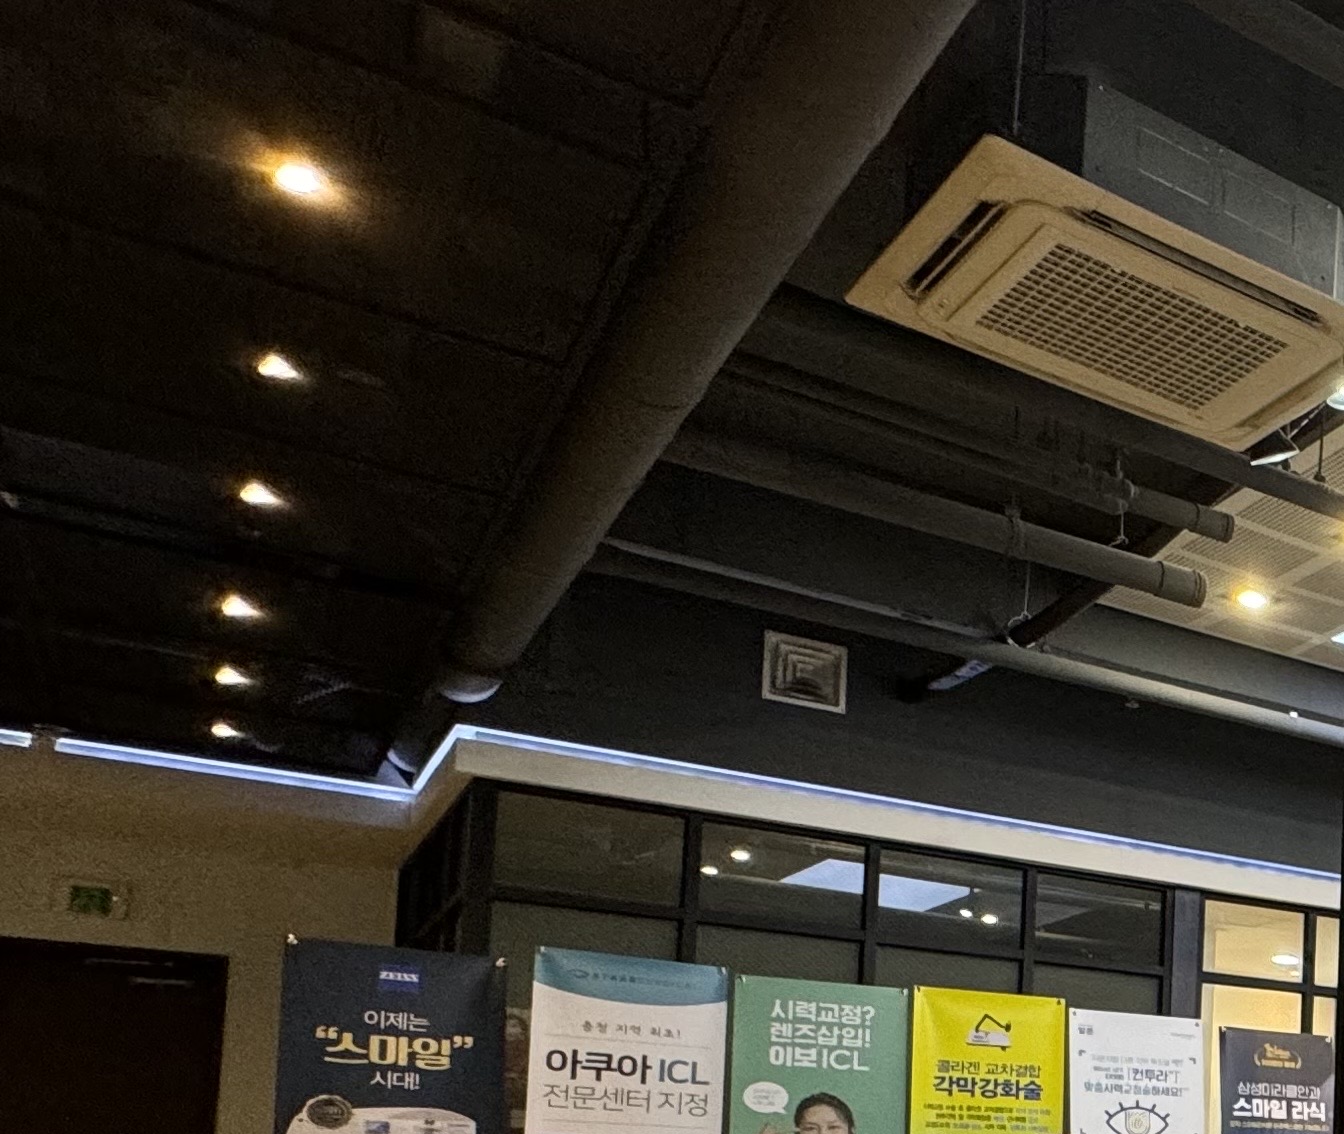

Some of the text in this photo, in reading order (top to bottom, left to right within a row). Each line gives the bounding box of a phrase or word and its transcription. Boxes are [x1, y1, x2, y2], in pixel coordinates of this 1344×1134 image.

[379, 970, 420, 983] ZEISS
[364, 1010, 430, 1032] 이제는
[771, 999, 875, 1026] 시력교정?
[615, 1023, 642, 1036] 지역
[770, 1022, 871, 1048] 렌즈삽입!
[546, 1048, 710, 1086] 아쿠아 ICL
[370, 1070, 420, 1091] 시대!
[933, 1075, 1043, 1101] 각막강화술
[1238, 1081, 1321, 1100] 삼성미라클안과
[543, 1083, 709, 1117] 전문센터 지정
[1232, 1097, 1326, 1122] 스마일 라식
